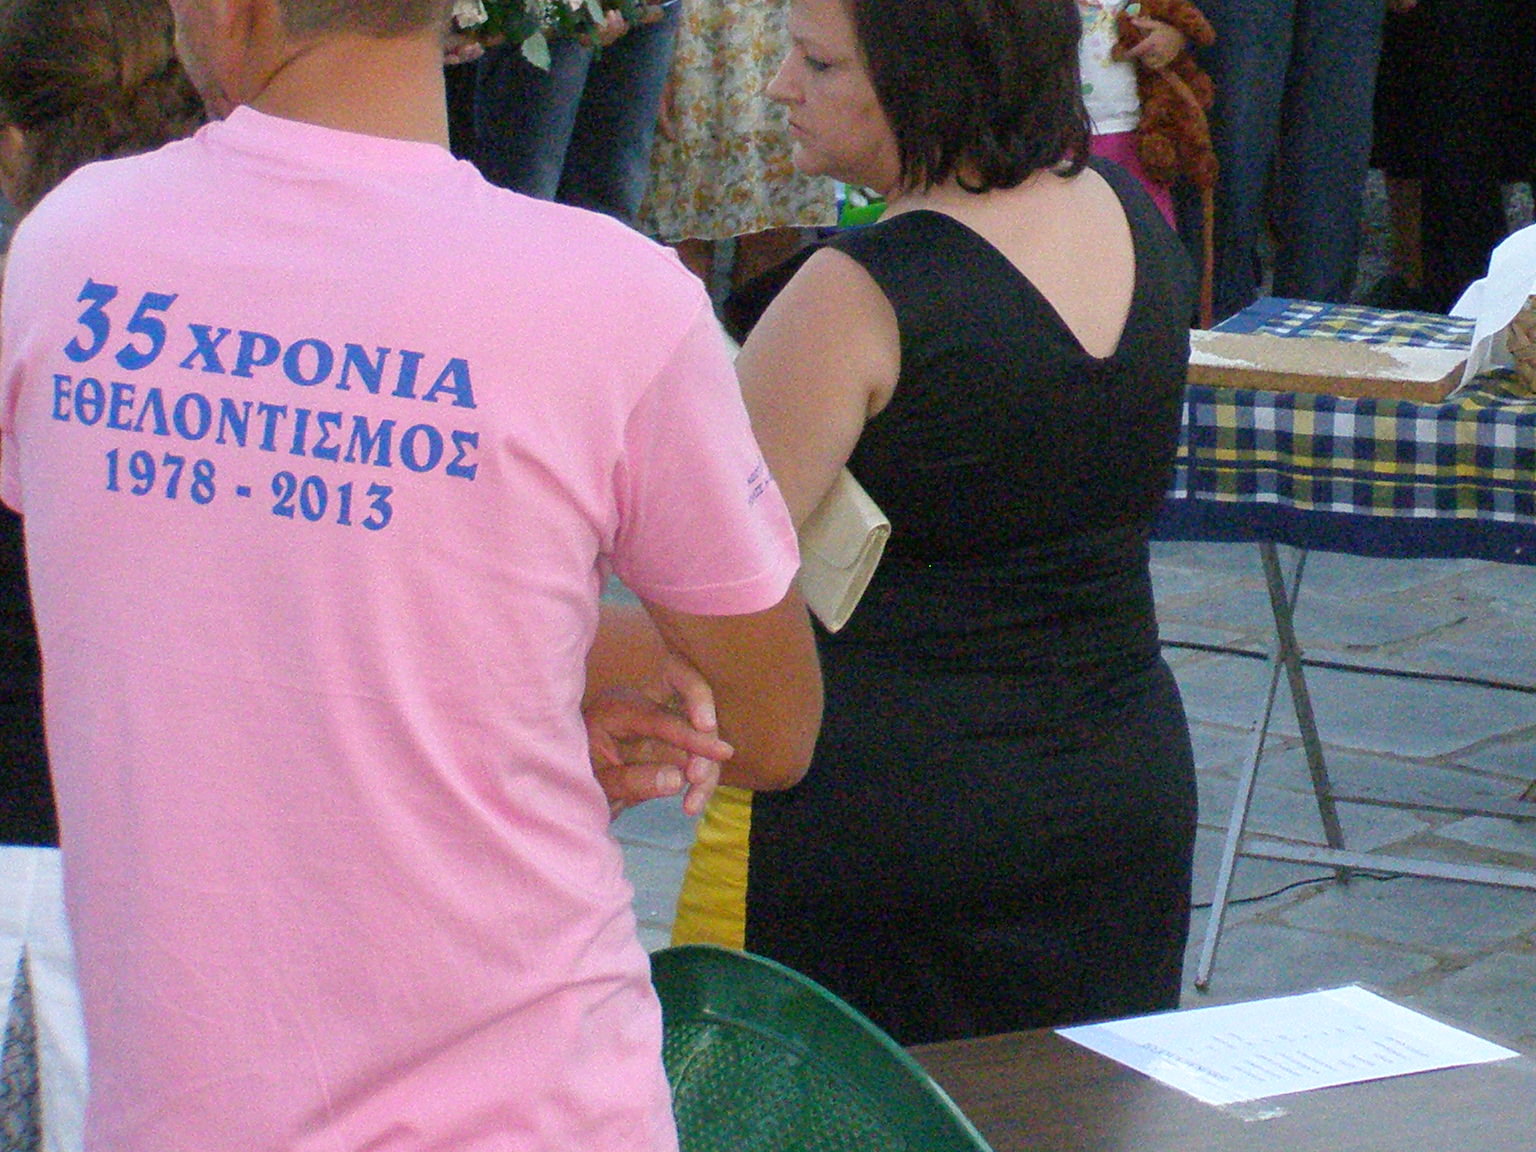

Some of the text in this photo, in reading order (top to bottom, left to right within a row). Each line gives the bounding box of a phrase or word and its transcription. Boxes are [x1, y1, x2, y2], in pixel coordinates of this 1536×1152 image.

[63, 278, 478, 410] 35 ΧΡΟΝΙΑ
[51, 373, 480, 482] ΕΘΕΛΟΝΤΙΣΜΟΣ
[105, 448, 394, 532] 1978 - 2013
